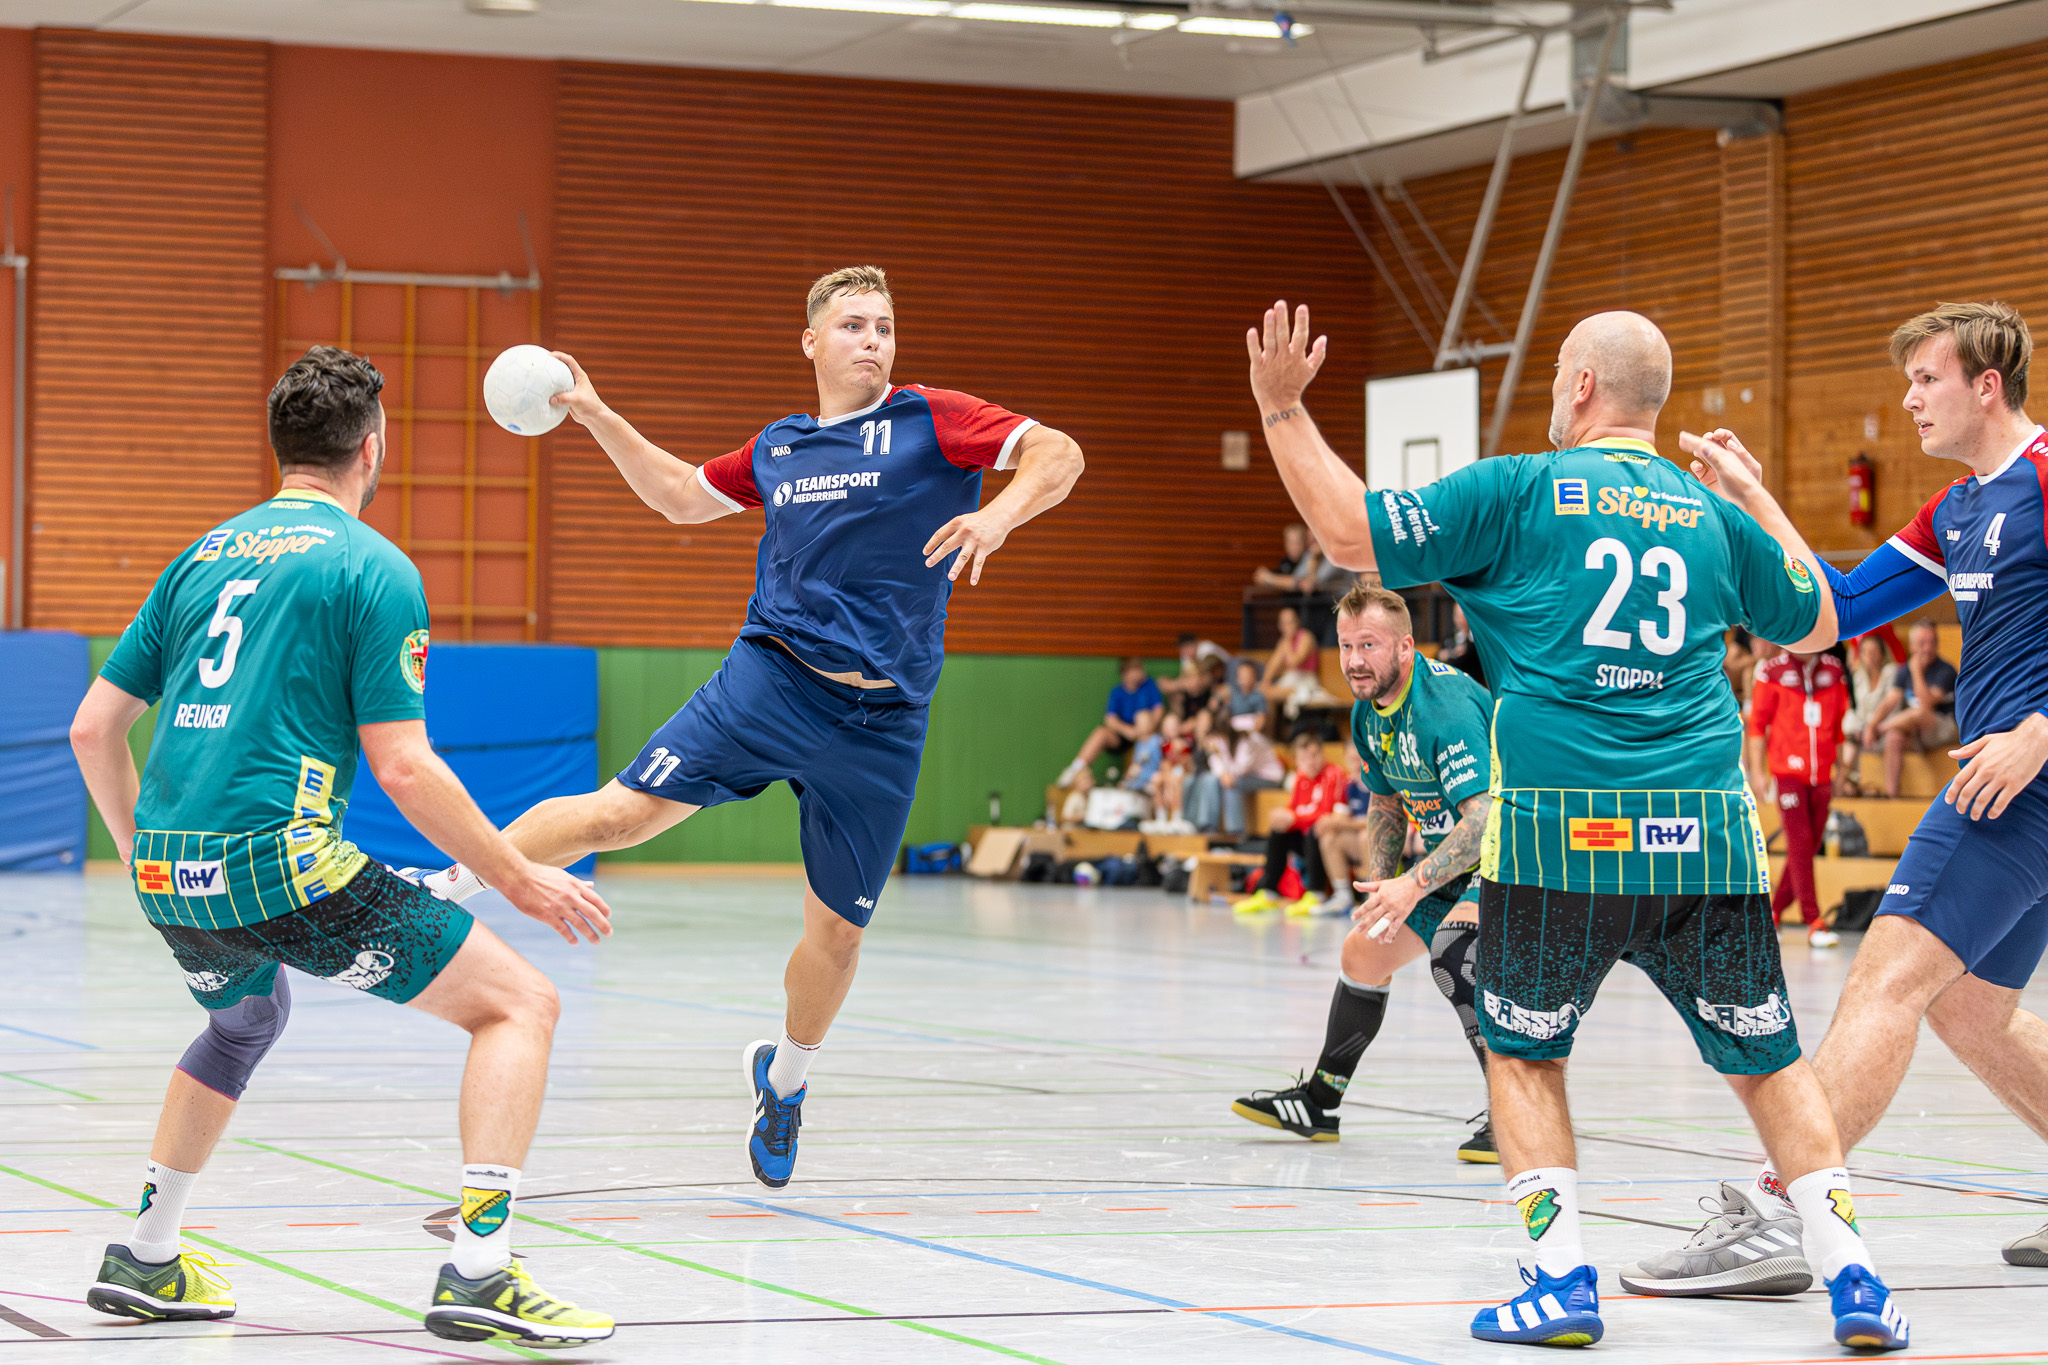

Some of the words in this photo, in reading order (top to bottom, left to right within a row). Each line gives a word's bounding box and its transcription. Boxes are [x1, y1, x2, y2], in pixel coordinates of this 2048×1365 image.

[860, 419, 892, 456] 11
[792, 489, 848, 504] NIEDERRHEIN
[795, 471, 881, 493] TEAMSPORT
[1596, 486, 1705, 532] Stepper
[1405, 506, 1427, 547] Verein.
[1983, 513, 2006, 557] 4
[226, 531, 327, 566] Stepper
[1583, 537, 1688, 656] 23
[198, 578, 261, 689] 5
[1595, 663, 1664, 689] STOPPA
[173, 703, 231, 728] REUKEN
[1398, 731, 1421, 767] 33
[1447, 739, 1468, 756] Dorf.
[1449, 754, 1477, 771] Verein.
[638, 746, 682, 788] 11
[1646, 824, 1695, 846] R+V
[179, 867, 219, 890] R+V
[1886, 884, 1910, 896] JAKO
